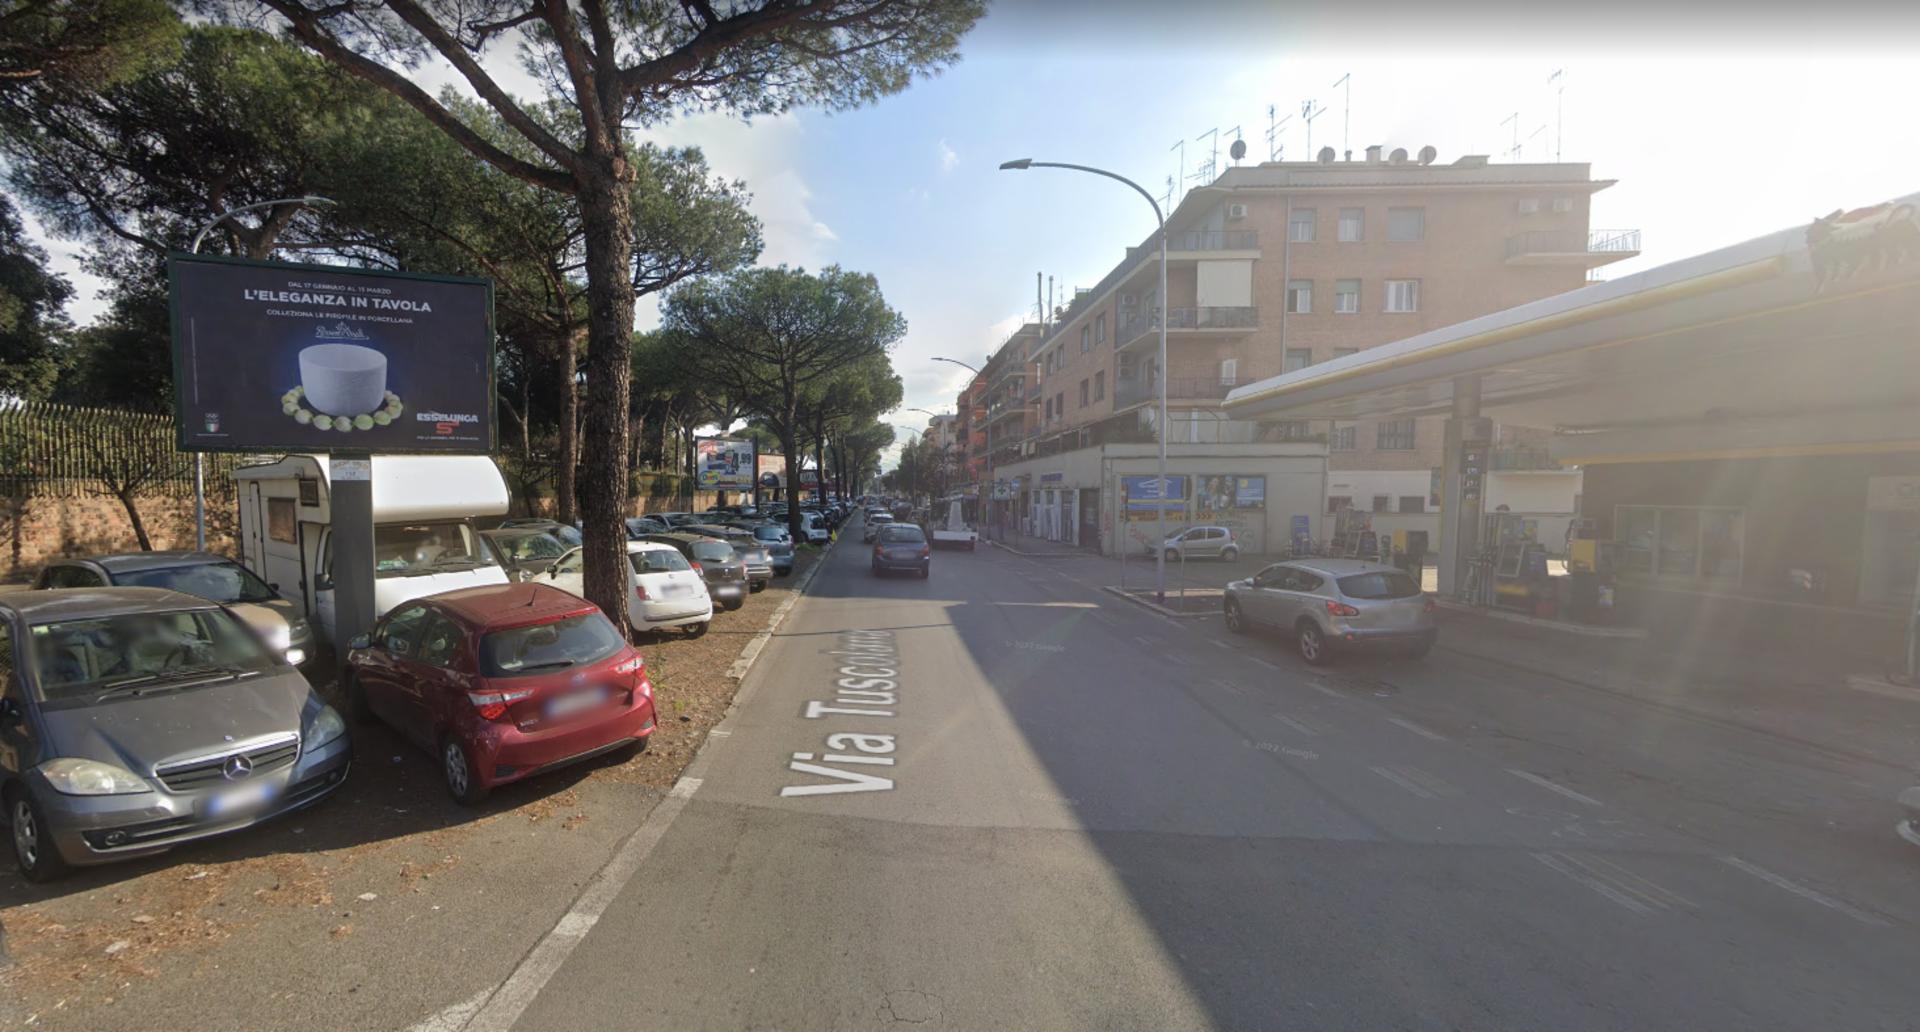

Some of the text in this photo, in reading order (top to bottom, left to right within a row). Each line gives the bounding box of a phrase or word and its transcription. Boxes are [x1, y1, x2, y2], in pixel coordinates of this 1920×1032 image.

[366, 287, 392, 295] MARZO
[244, 288, 432, 313] L'ELEGANZA IN TAVOLA
[266, 308, 314, 318] COLLEZIONA
[367, 315, 414, 324] PORCELLANA
[416, 412, 479, 423] ESSELUNGA
